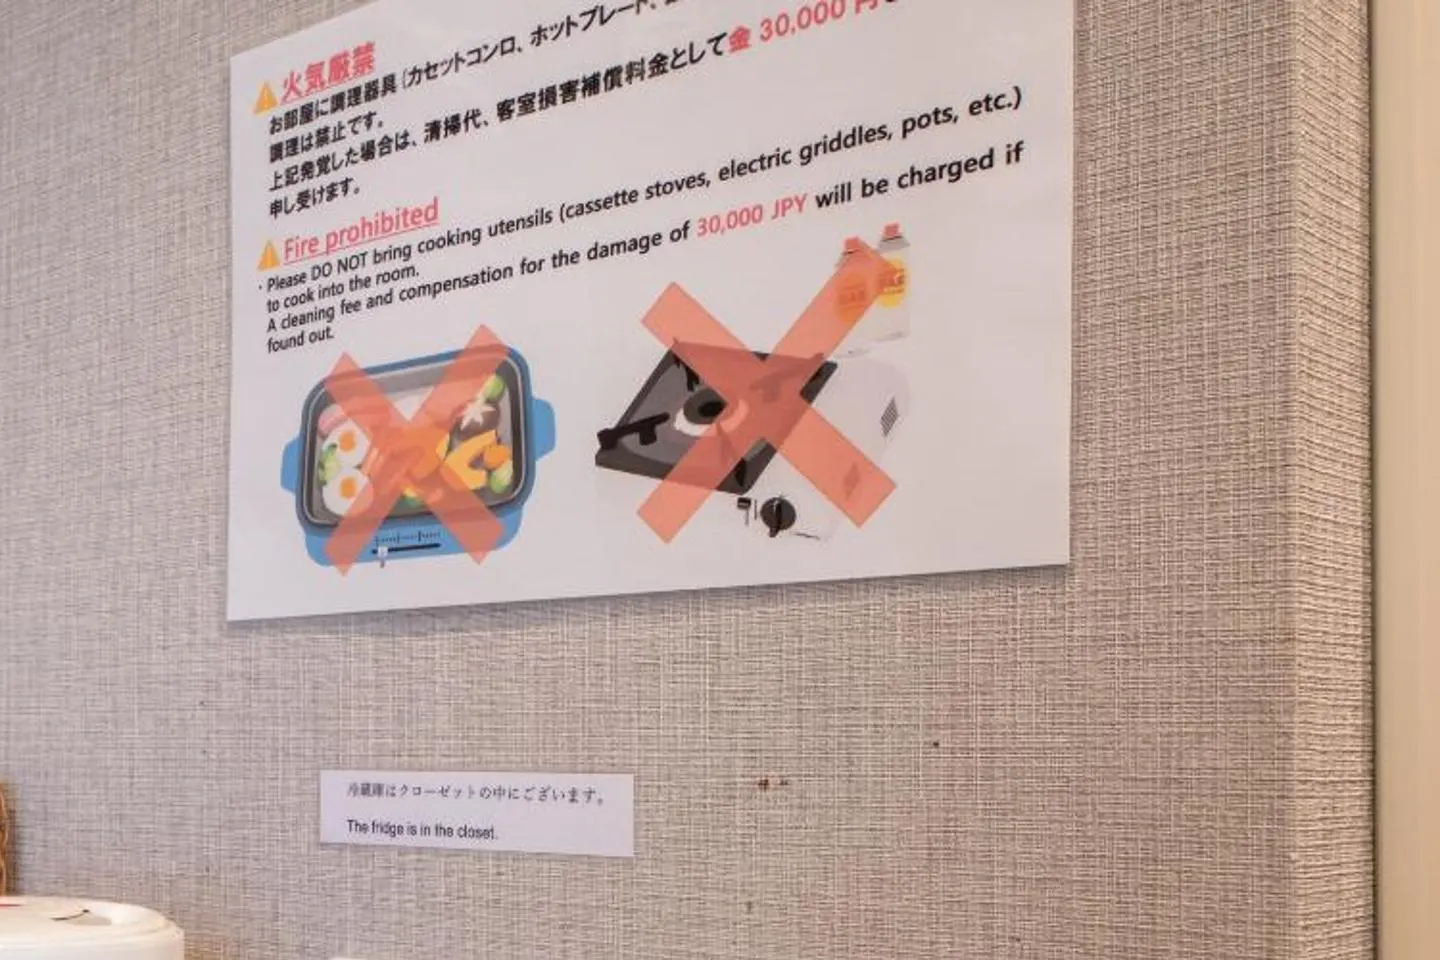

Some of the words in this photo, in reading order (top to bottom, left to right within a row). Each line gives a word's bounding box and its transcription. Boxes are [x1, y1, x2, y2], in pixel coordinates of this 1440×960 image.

[281, 41, 375, 101] 火気厳禁
[269, 111, 383, 164] 調理は禁止です。
[267, 271, 307, 292] Please
[311, 262, 332, 282] DO
[337, 252, 368, 273] NOT
[373, 245, 412, 263] bring
[418, 228, 481, 253] cooking
[488, 208, 553, 237] utensils
[559, 188, 639, 223] (cassette
[645, 170, 710, 201] stoves,
[718, 146, 791, 182] electric
[800, 125, 893, 166] griddles,
[901, 104, 959, 139] pots,
[969, 86, 1022, 117] etc.)
[270, 177, 360, 219] 申し受けます。
[267, 318, 277, 333] A
[281, 306, 335, 330] cleaning
[340, 298, 362, 315] fee
[366, 288, 393, 309] and
[398, 264, 513, 301] compensation
[520, 257, 546, 276] for
[552, 249, 581, 269] the
[587, 231, 662, 260] damage
[669, 220, 691, 242] of
[697, 204, 763, 237] 30,000
[771, 194, 808, 222] JPY
[815, 183, 852, 209] will
[861, 177, 889, 199] be
[897, 149, 995, 190] charged
[1005, 140, 1025, 166] if
[284, 236, 319, 261] Fire
[326, 196, 439, 255] prohibited
[267, 298, 279, 313] to
[284, 288, 314, 310] cook
[318, 283, 344, 299] into
[349, 275, 371, 292] the
[376, 266, 420, 285] room.
[267, 330, 304, 354] found
[309, 325, 334, 344] out.
[347, 782, 604, 806] 冷蔵庫はクローゼットの中にございます。
[347, 819, 369, 834] The
[371, 820, 404, 838] fridge
[407, 823, 418, 836] is
[420, 823, 431, 837] in
[435, 822, 454, 837] the
[457, 824, 499, 840] closet.
